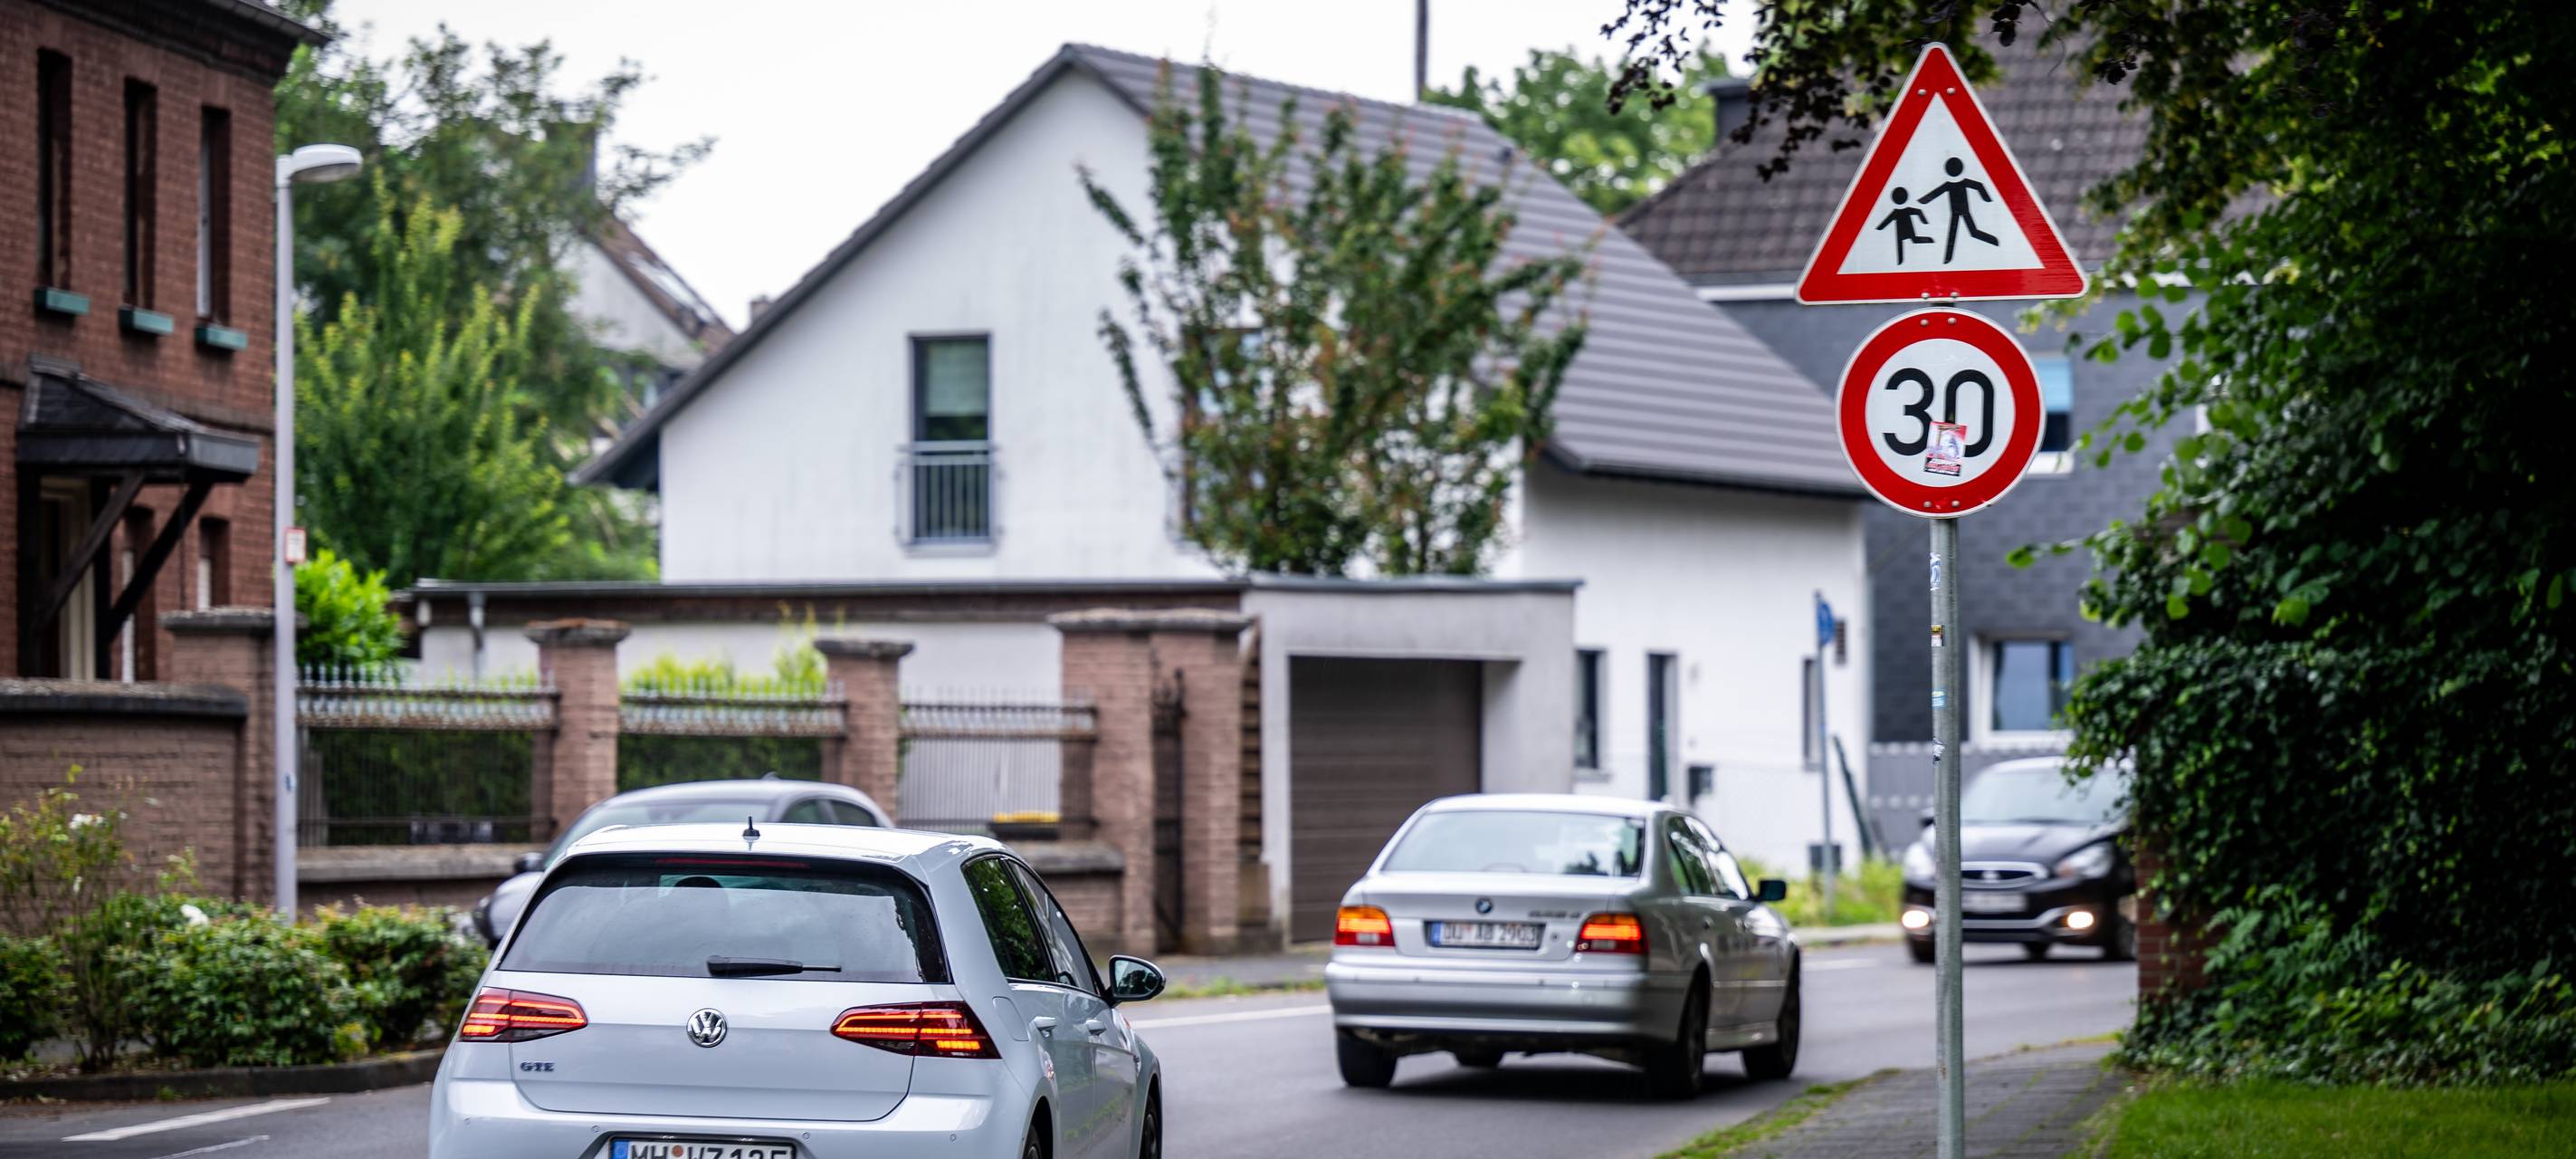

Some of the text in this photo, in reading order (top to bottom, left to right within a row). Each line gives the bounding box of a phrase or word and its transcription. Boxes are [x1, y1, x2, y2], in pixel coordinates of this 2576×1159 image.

[1883, 368, 1994, 458] 30
[520, 1061, 553, 1071] GTE
[631, 1145, 670, 1159] MH
